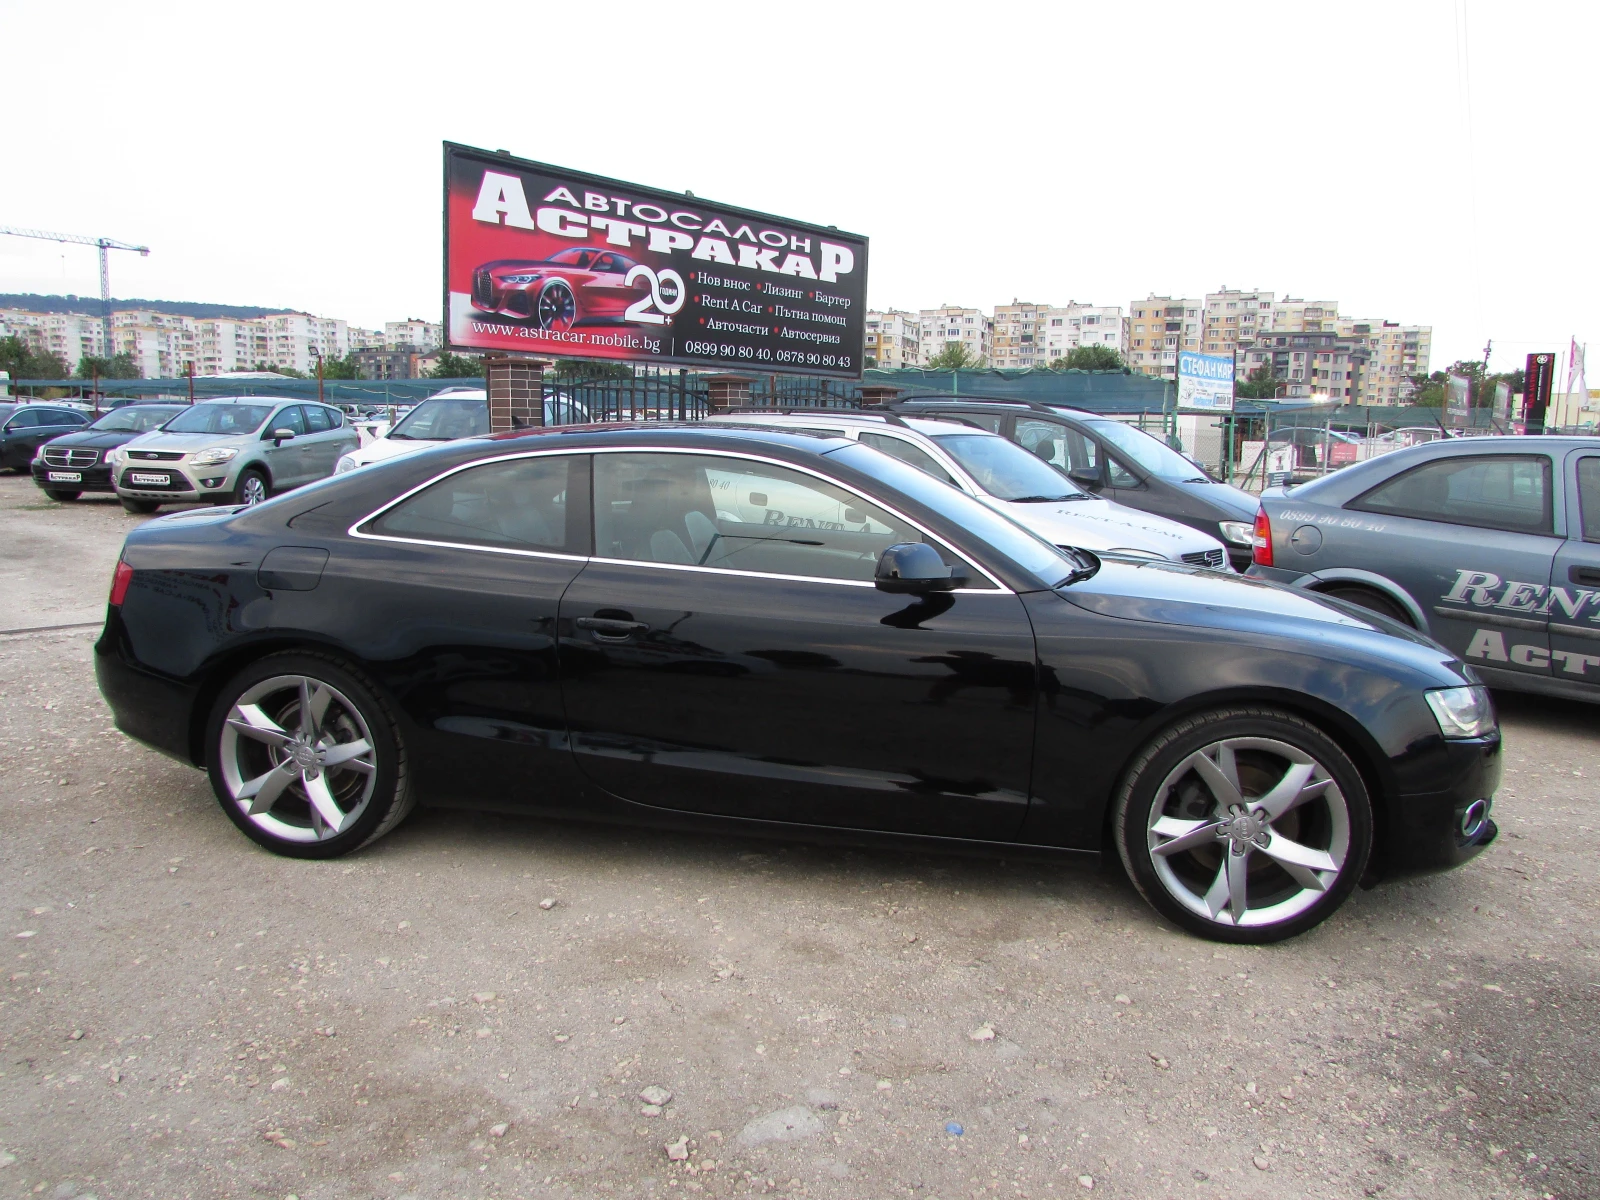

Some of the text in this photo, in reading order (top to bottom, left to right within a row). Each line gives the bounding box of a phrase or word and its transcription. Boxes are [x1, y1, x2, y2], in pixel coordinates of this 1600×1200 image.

[472, 171, 854, 283] АСТРАКАР
[543, 186, 811, 253] АВТОСАЛОН
[660, 287, 678, 297] ГОДИНИ
[698, 271, 850, 309] Нов внос Лизинг Бартер
[702, 295, 847, 327] Rent A Car Пътна помощ
[472, 321, 660, 353] www.astracar.mobile.bg
[706, 317, 840, 345] Авточасти Автосервиз
[685, 340, 851, 368] 0899 90 80 40, 0878 90 80 43
[1180, 355, 1233, 379] СТЕФАН КАР
[720, 481, 730, 490] 40
